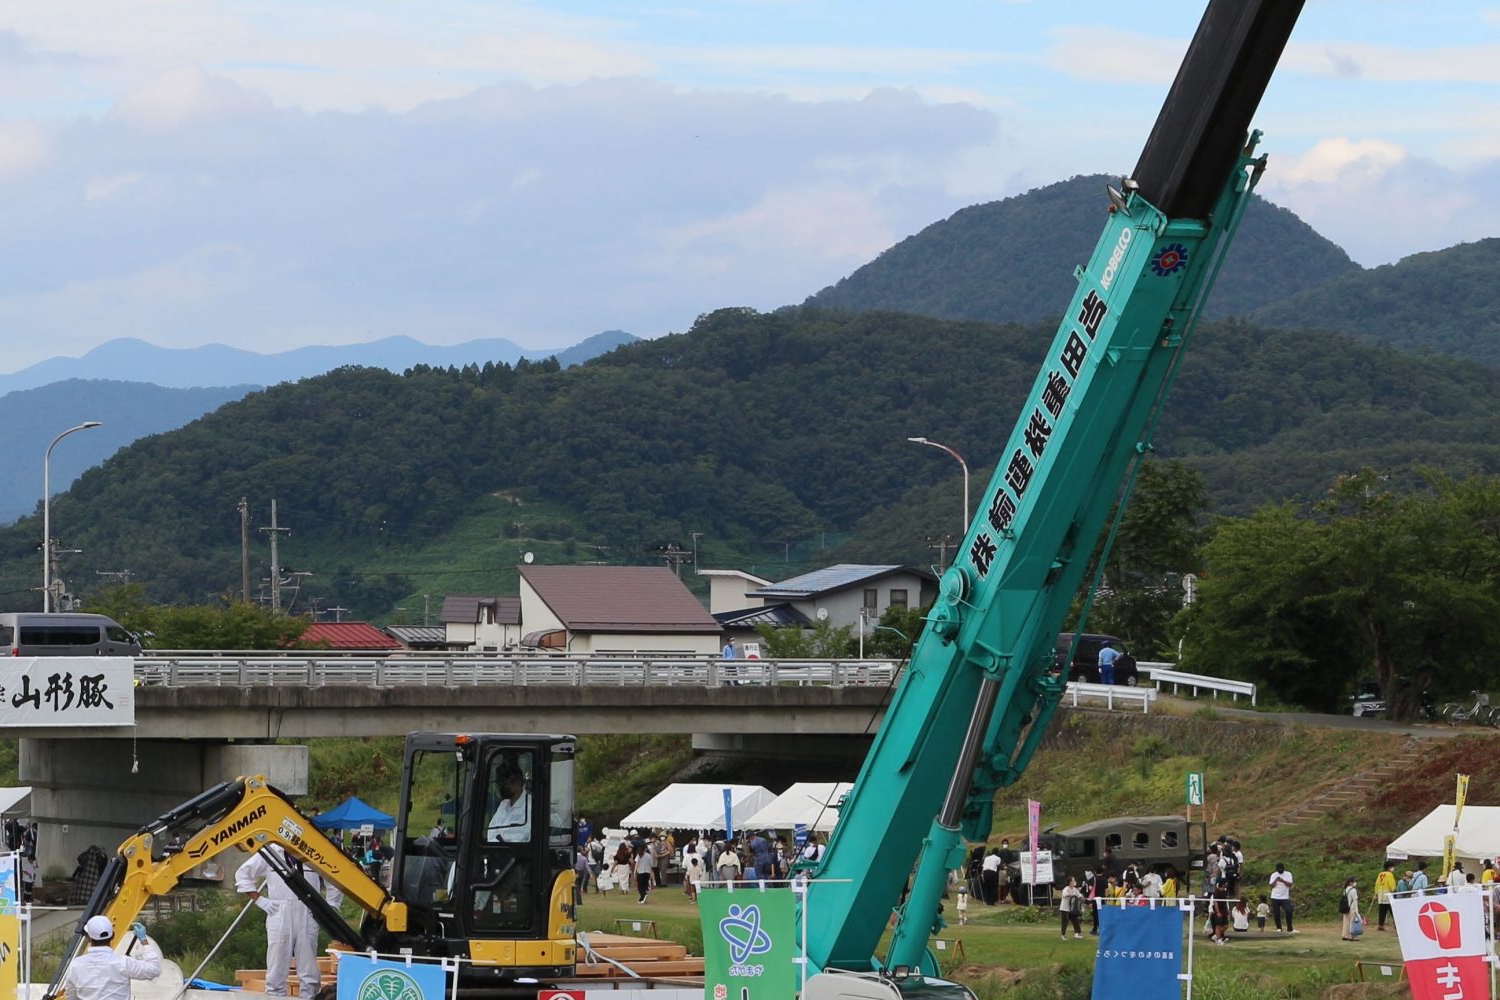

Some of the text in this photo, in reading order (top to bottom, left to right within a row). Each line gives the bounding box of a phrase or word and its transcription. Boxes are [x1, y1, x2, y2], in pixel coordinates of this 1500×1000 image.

[1100, 227, 1132, 291] KOBELCO
[12, 674, 114, 712] 山形豚
[211, 804, 267, 846] YANMAR
